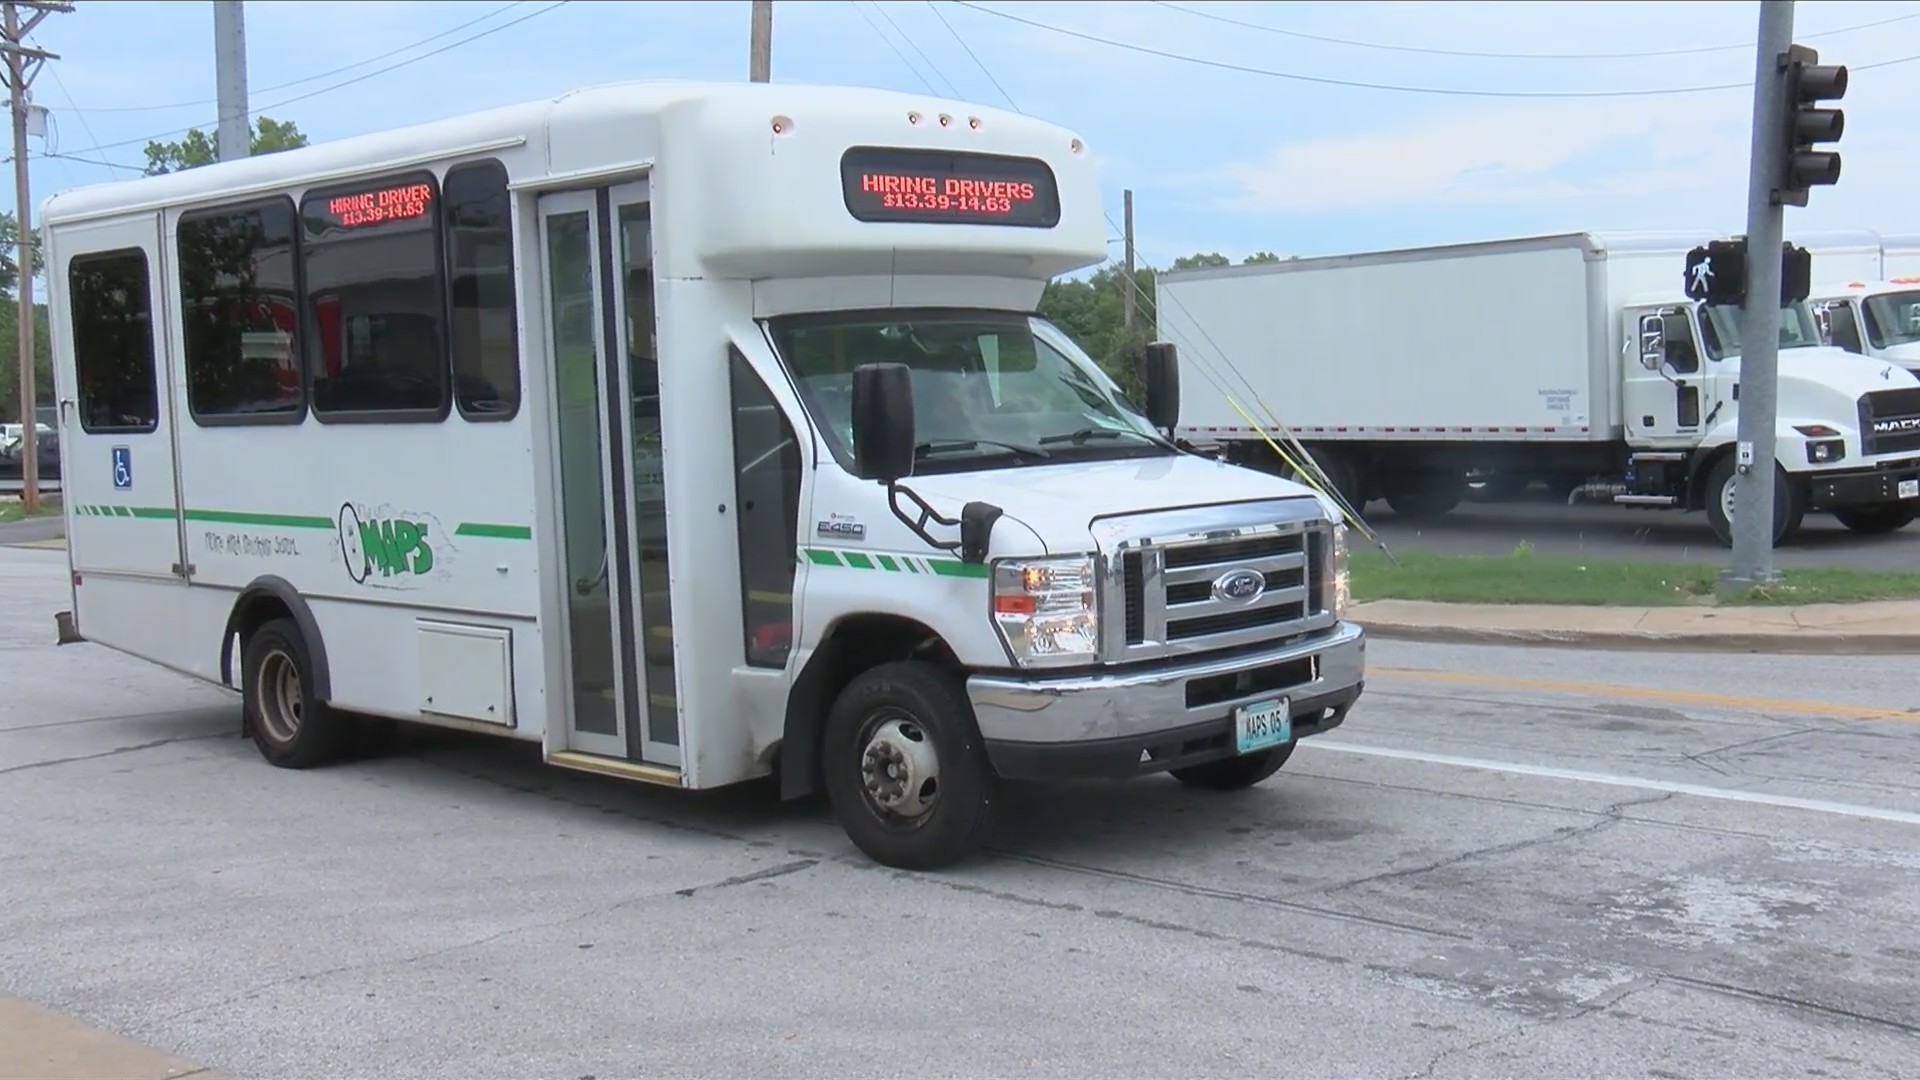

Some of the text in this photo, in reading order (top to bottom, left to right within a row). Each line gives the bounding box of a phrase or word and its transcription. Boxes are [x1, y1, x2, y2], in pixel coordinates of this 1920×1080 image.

[862, 175, 1034, 199] HIRING DRIVERS
[330, 184, 430, 213] HIRING DRIVER
[883, 193, 1011, 212] $13.39-14.63
[1874, 418, 1920, 432] MACK
